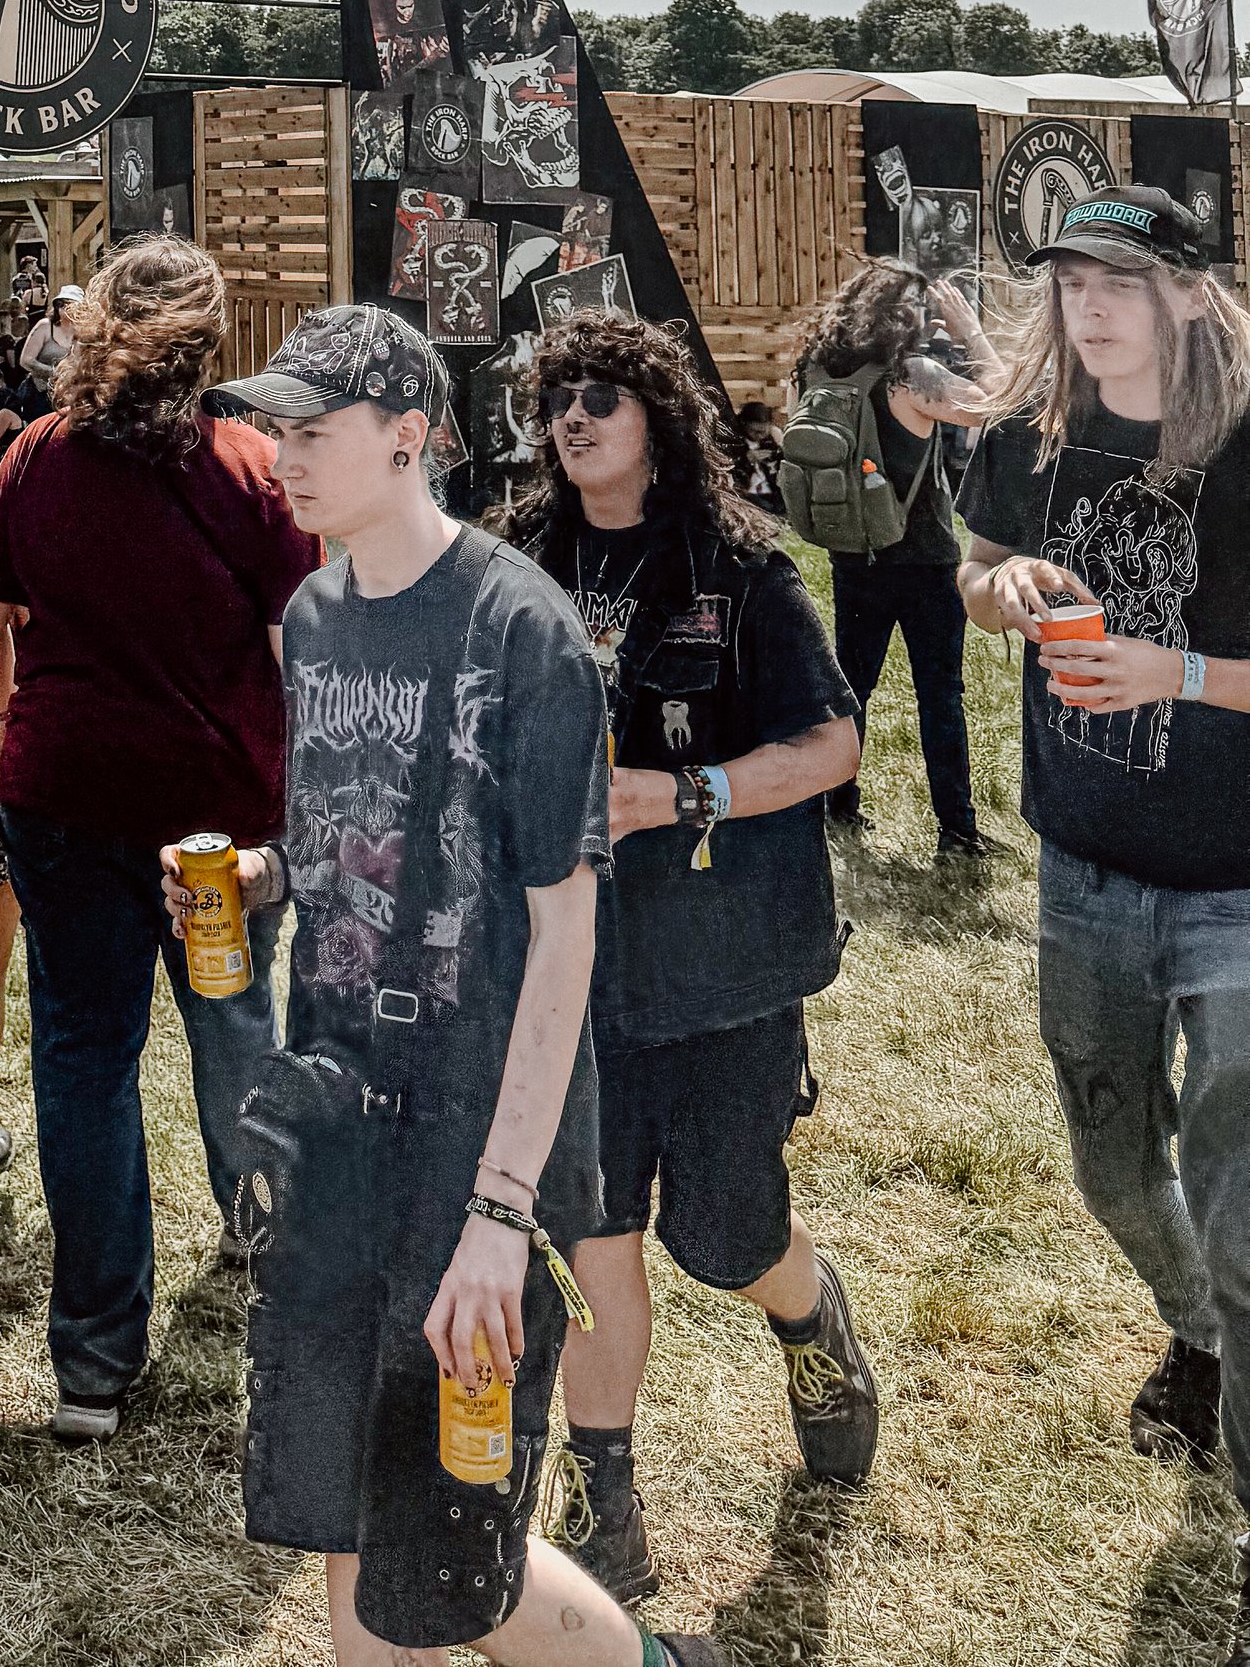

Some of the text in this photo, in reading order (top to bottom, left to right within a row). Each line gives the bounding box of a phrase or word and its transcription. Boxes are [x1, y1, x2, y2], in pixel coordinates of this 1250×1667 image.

[37, 86, 103, 135] BAR
[425, 107, 468, 140] THE IRON HARP
[1004, 159, 1026, 215] THE
[1022, 130, 1074, 162] IRON
